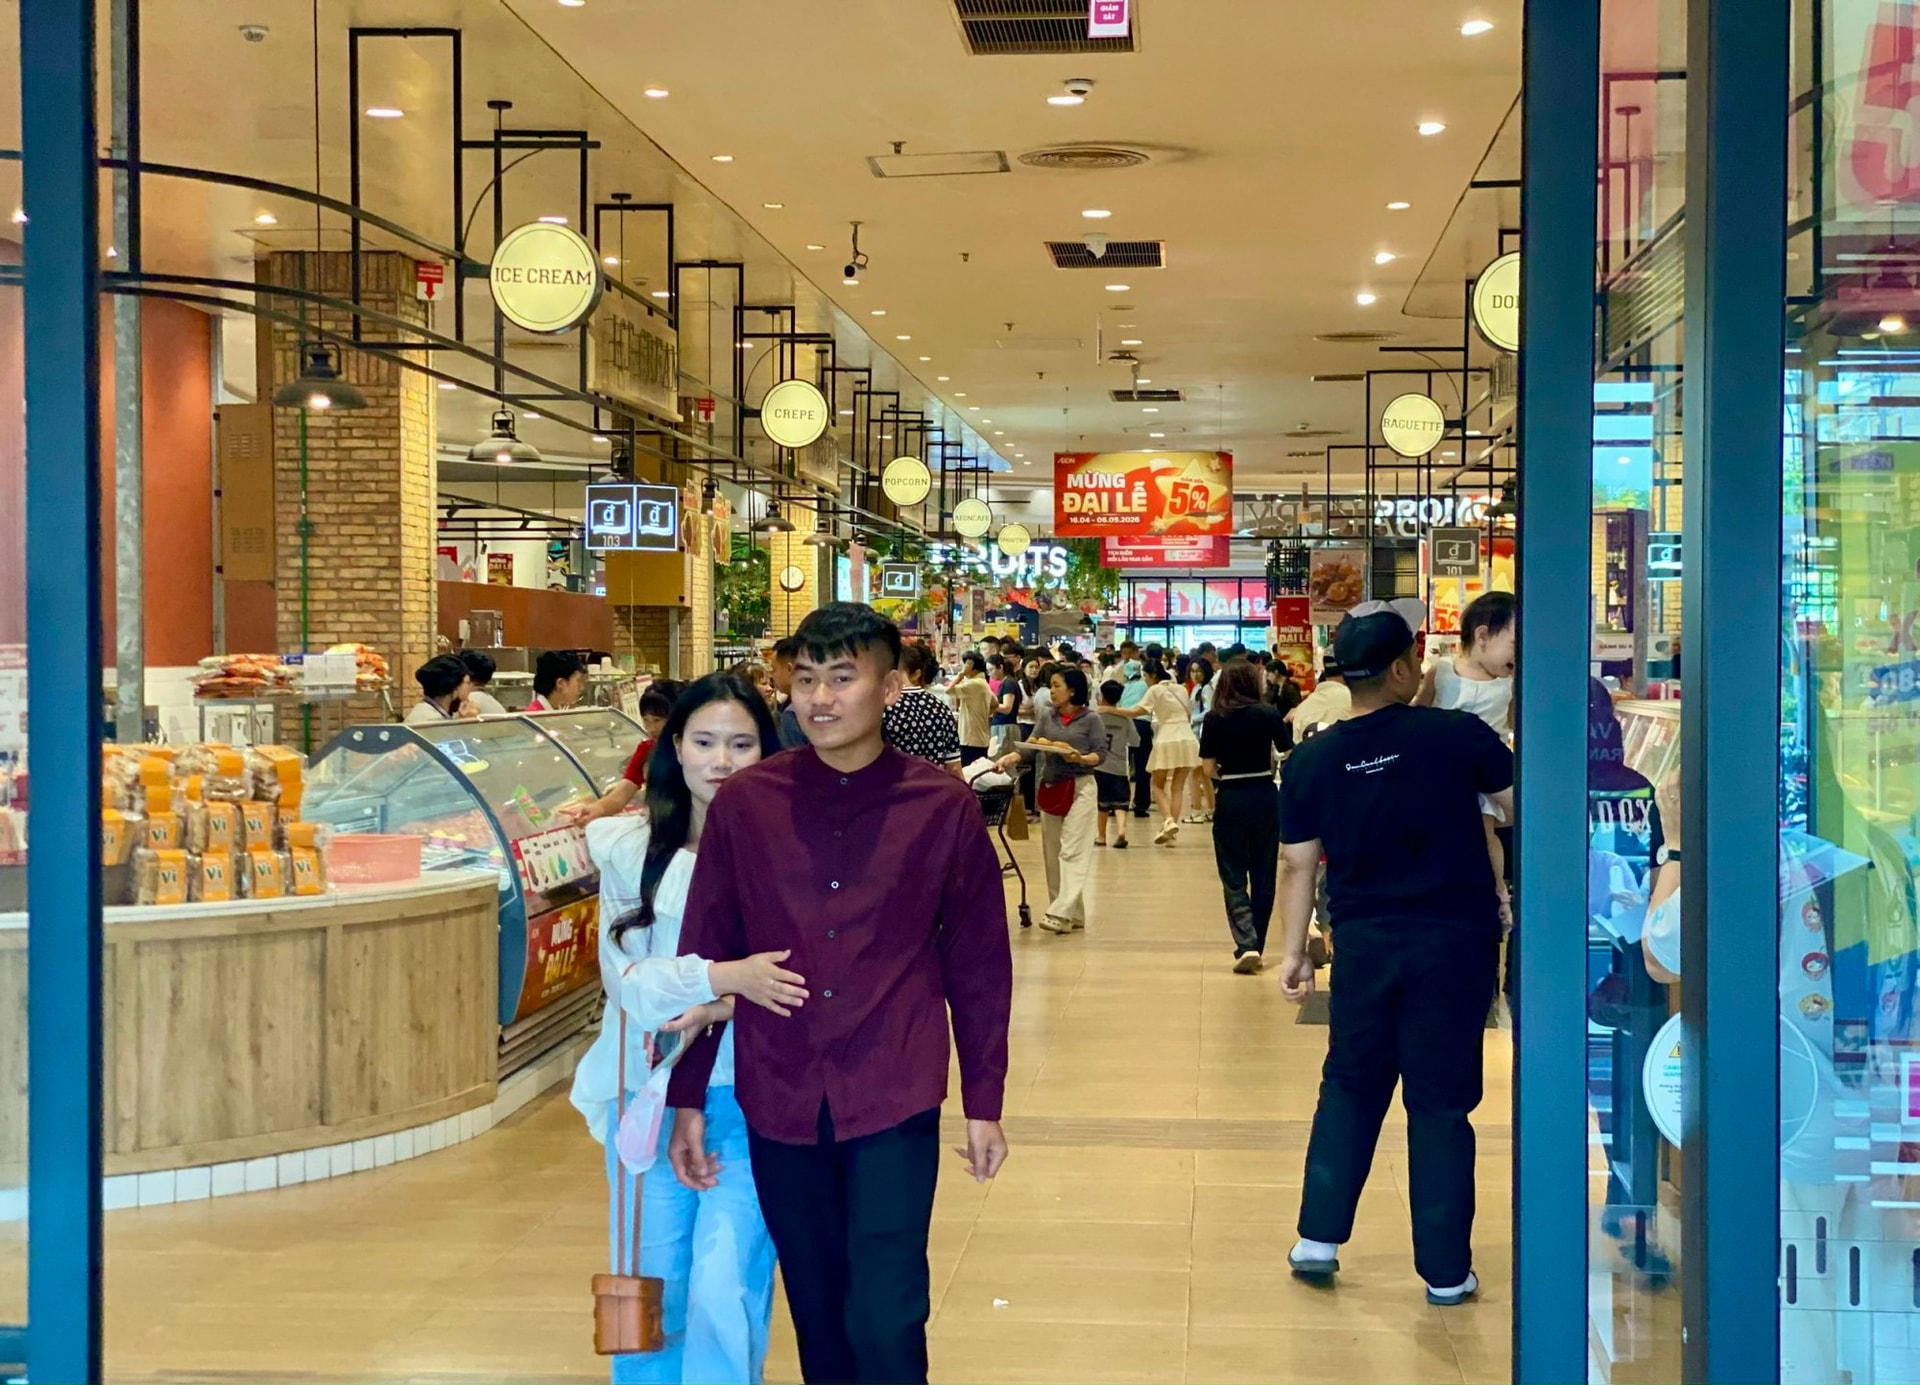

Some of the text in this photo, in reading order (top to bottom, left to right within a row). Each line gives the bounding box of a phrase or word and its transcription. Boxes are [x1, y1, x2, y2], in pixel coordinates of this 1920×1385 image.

[495, 267, 592, 286] ICE CREAM
[1493, 294, 1519, 310] DO
[774, 408, 815, 421] CREPE
[1383, 418, 1443, 433] BAGUETTE
[884, 477, 929, 487] POPCORN
[1067, 469, 1126, 489] MỪNG
[1063, 480, 1148, 515] ĐẠI LỄ
[602, 535, 621, 547] 103
[1446, 566, 1463, 576] 101
